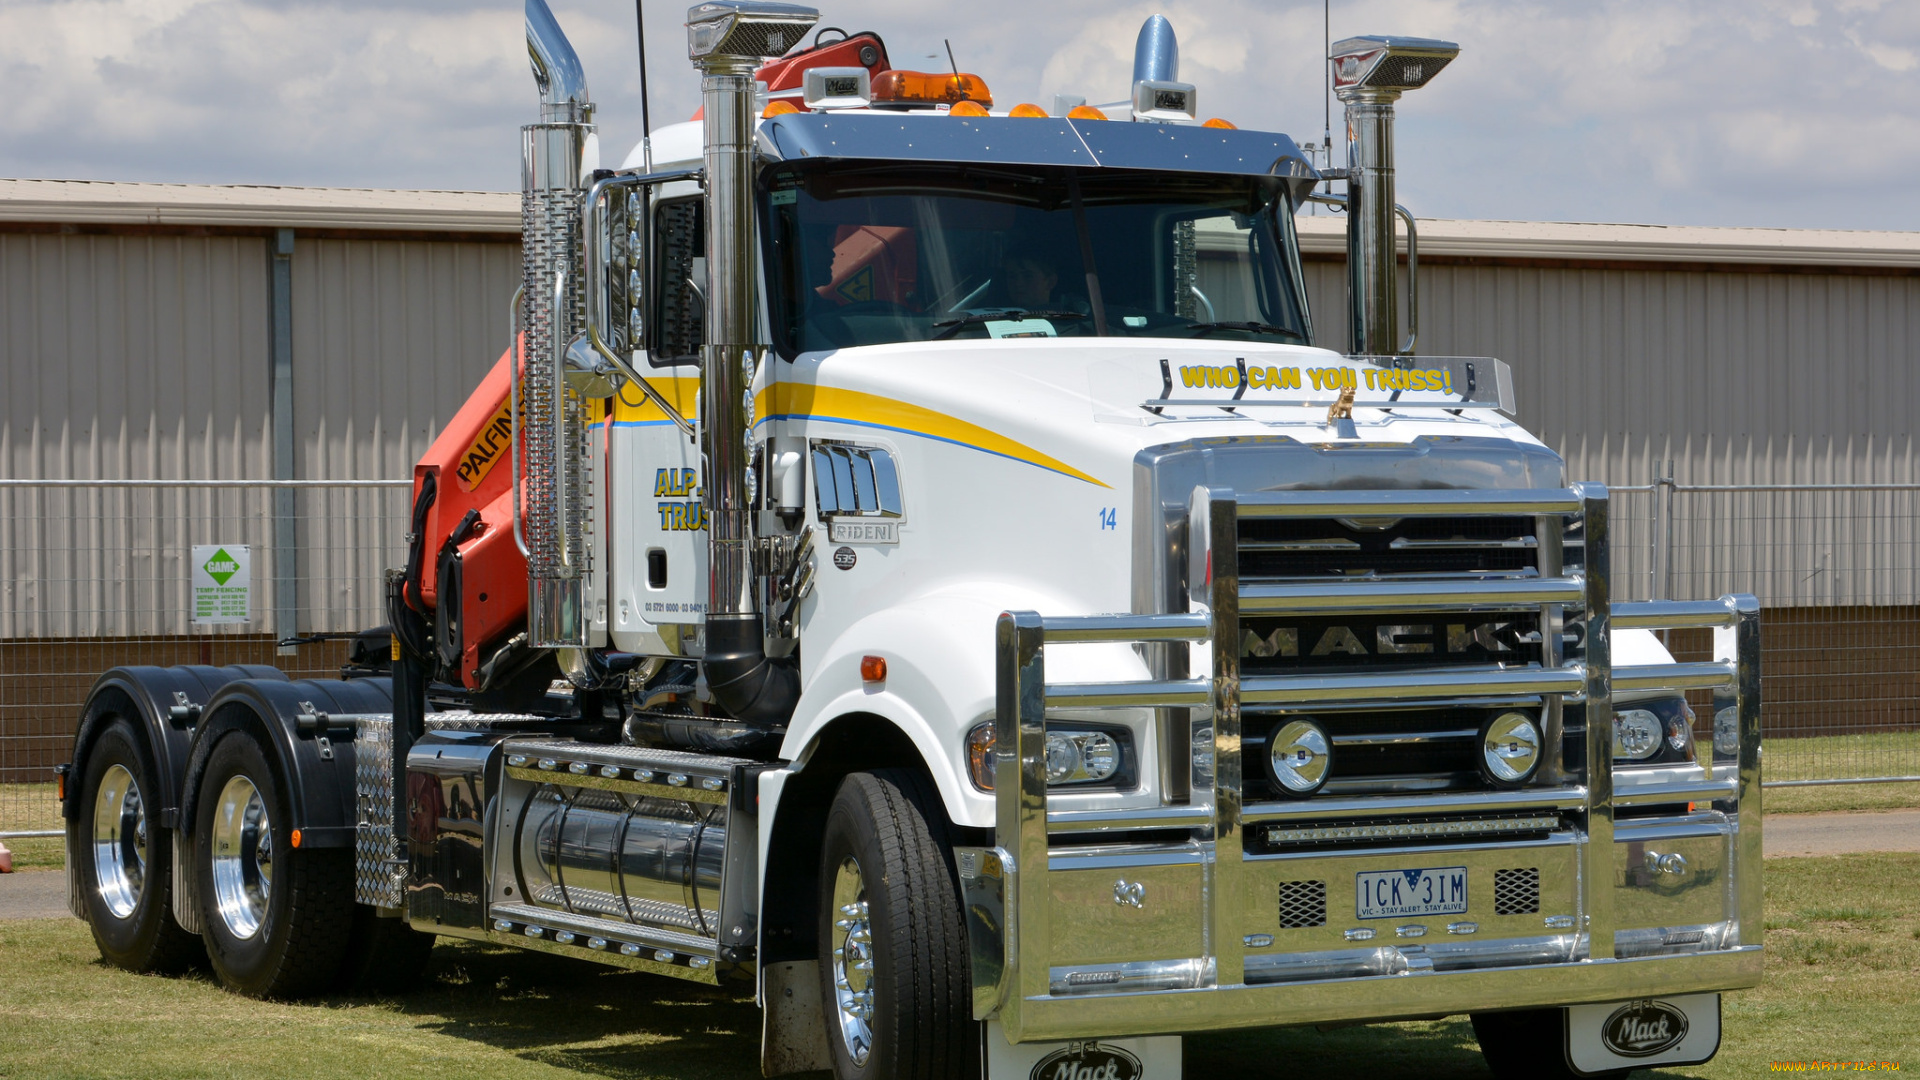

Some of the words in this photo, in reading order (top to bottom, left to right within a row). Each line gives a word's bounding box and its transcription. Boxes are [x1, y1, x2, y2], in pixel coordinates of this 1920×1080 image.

[1179, 365, 1241, 389] WHO
[1247, 365, 1301, 391] CAN
[1306, 367, 1357, 391] YOU
[1362, 367, 1453, 395] TRUSS!
[456, 400, 525, 483] PALFIN
[654, 468, 703, 497] ALP
[1099, 507, 1117, 531] 14
[208, 561, 236, 573] GAME
[833, 554, 856, 564] 535
[645, 602, 652, 612] 03
[681, 603, 689, 613] 03
[1239, 622, 1512, 657] MACK
[1363, 877, 1403, 908] 1CK
[1361, 908, 1374, 916] VIC
[1381, 906, 1399, 915] STAY
[1400, 905, 1421, 914] ALERT
[1424, 904, 1442, 912] STAY
[1443, 903, 1463, 911] ALIVE
[1616, 1013, 1672, 1044] Mack
[1051, 1058, 1124, 1080] Mack
